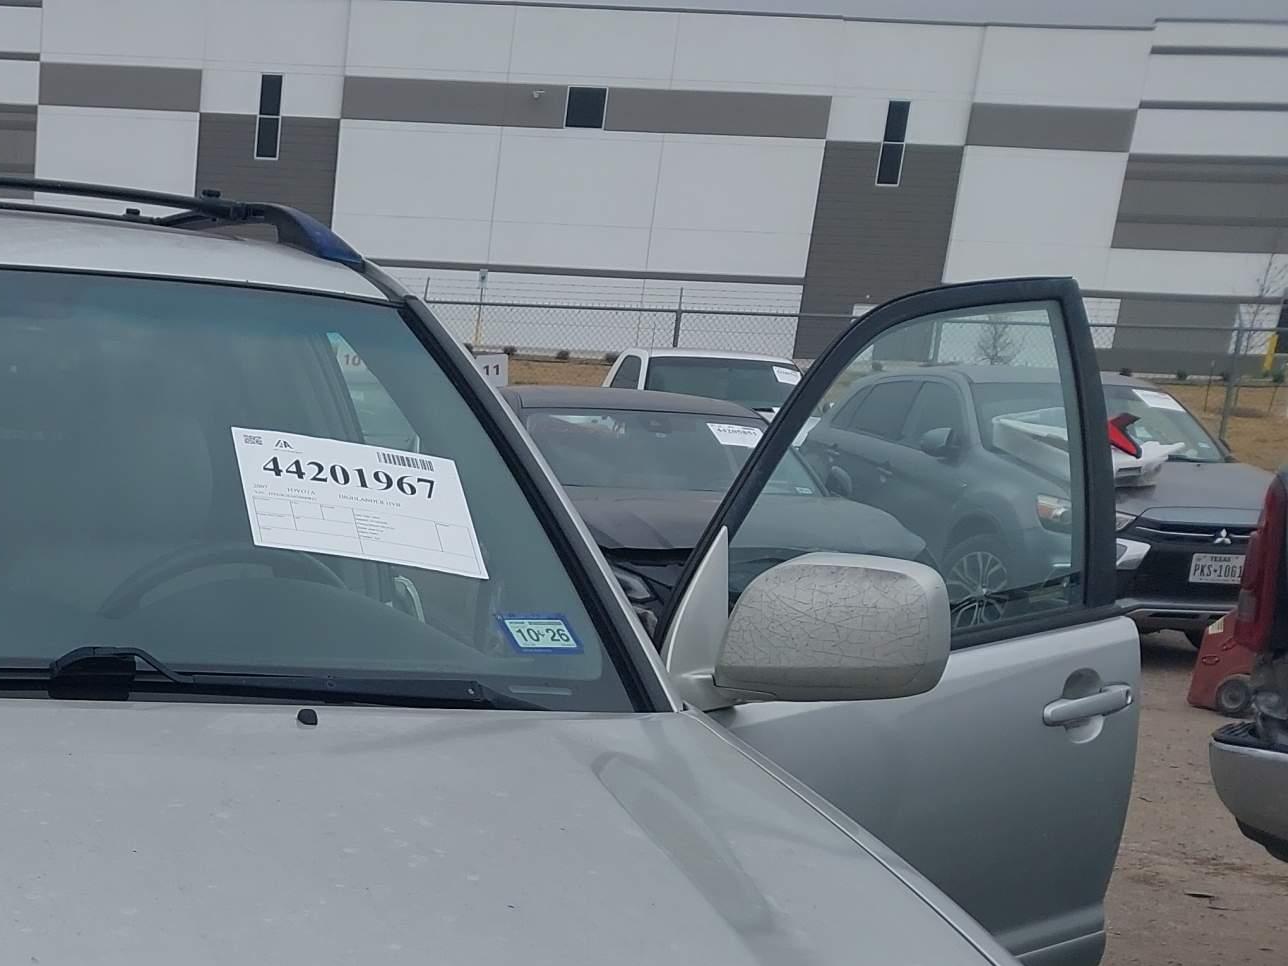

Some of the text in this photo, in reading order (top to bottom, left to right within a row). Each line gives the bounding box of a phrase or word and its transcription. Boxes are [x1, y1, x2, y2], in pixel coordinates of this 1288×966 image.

[343, 353, 361, 367] 10
[482, 363, 501, 377] 11
[262, 456, 436, 499] 44201967
